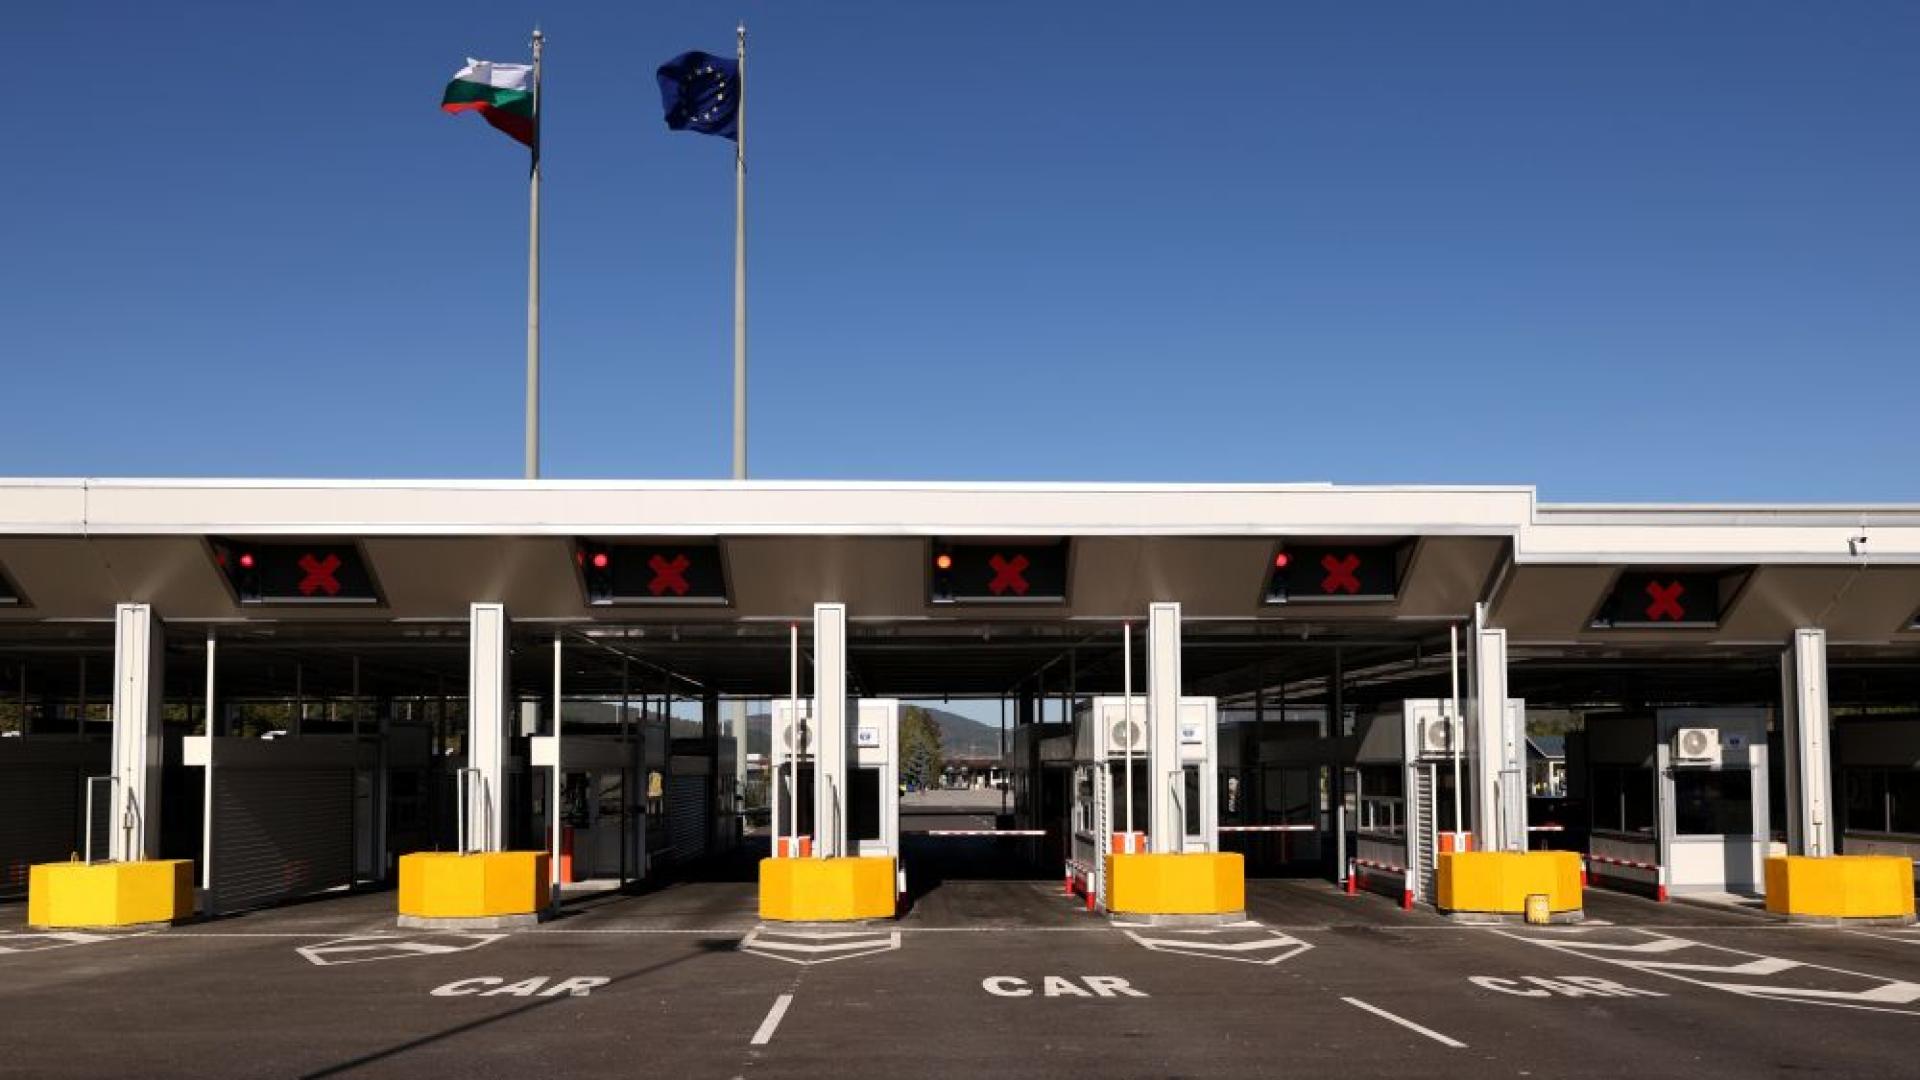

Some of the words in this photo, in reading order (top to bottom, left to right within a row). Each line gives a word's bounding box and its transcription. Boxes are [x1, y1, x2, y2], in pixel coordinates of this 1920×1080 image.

[430, 975, 611, 997] CAR
[982, 975, 1150, 998] CAR
[1467, 975, 1671, 997] CAR
